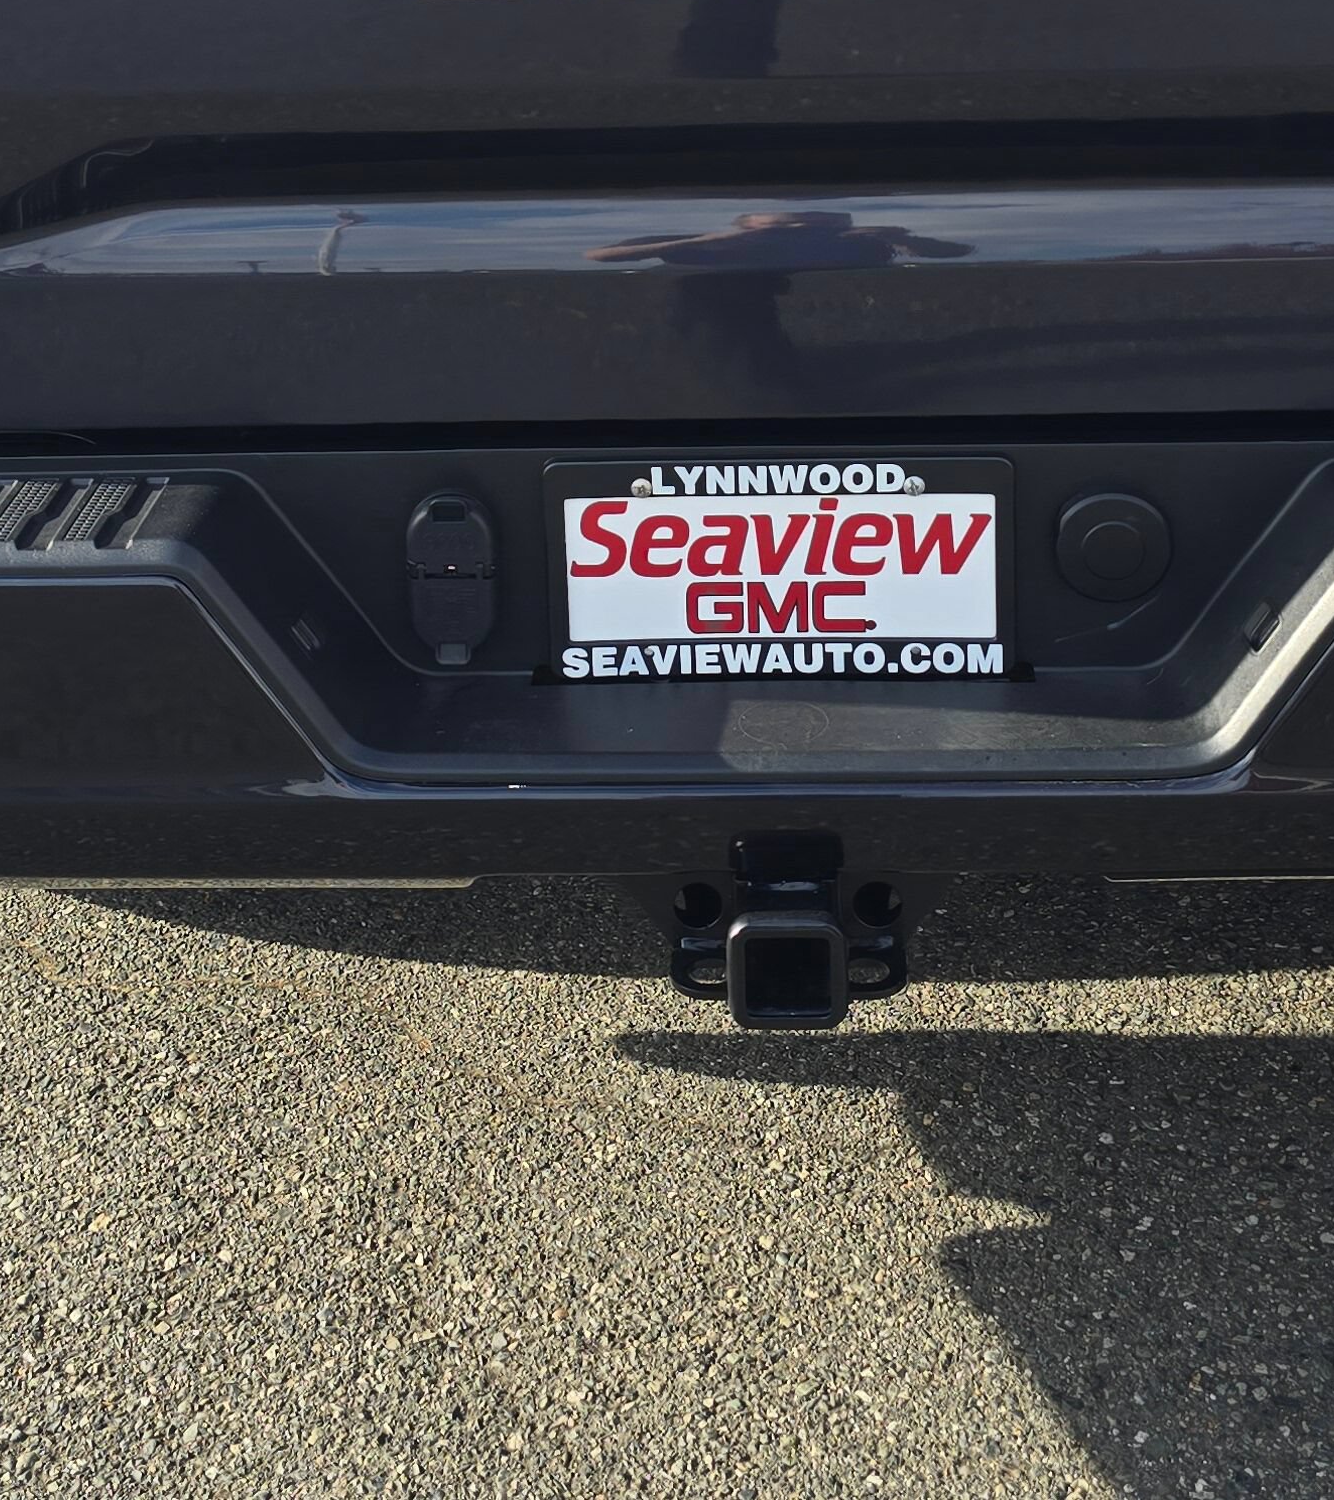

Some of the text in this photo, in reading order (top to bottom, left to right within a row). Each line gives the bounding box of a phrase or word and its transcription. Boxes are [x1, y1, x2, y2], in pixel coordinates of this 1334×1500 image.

[650, 463, 906, 496] LYNNWOOD
[569, 497, 993, 578] Seaview
[685, 580, 867, 634] GMC
[562, 642, 1004, 679] SEAVIEWAUTO.COM
